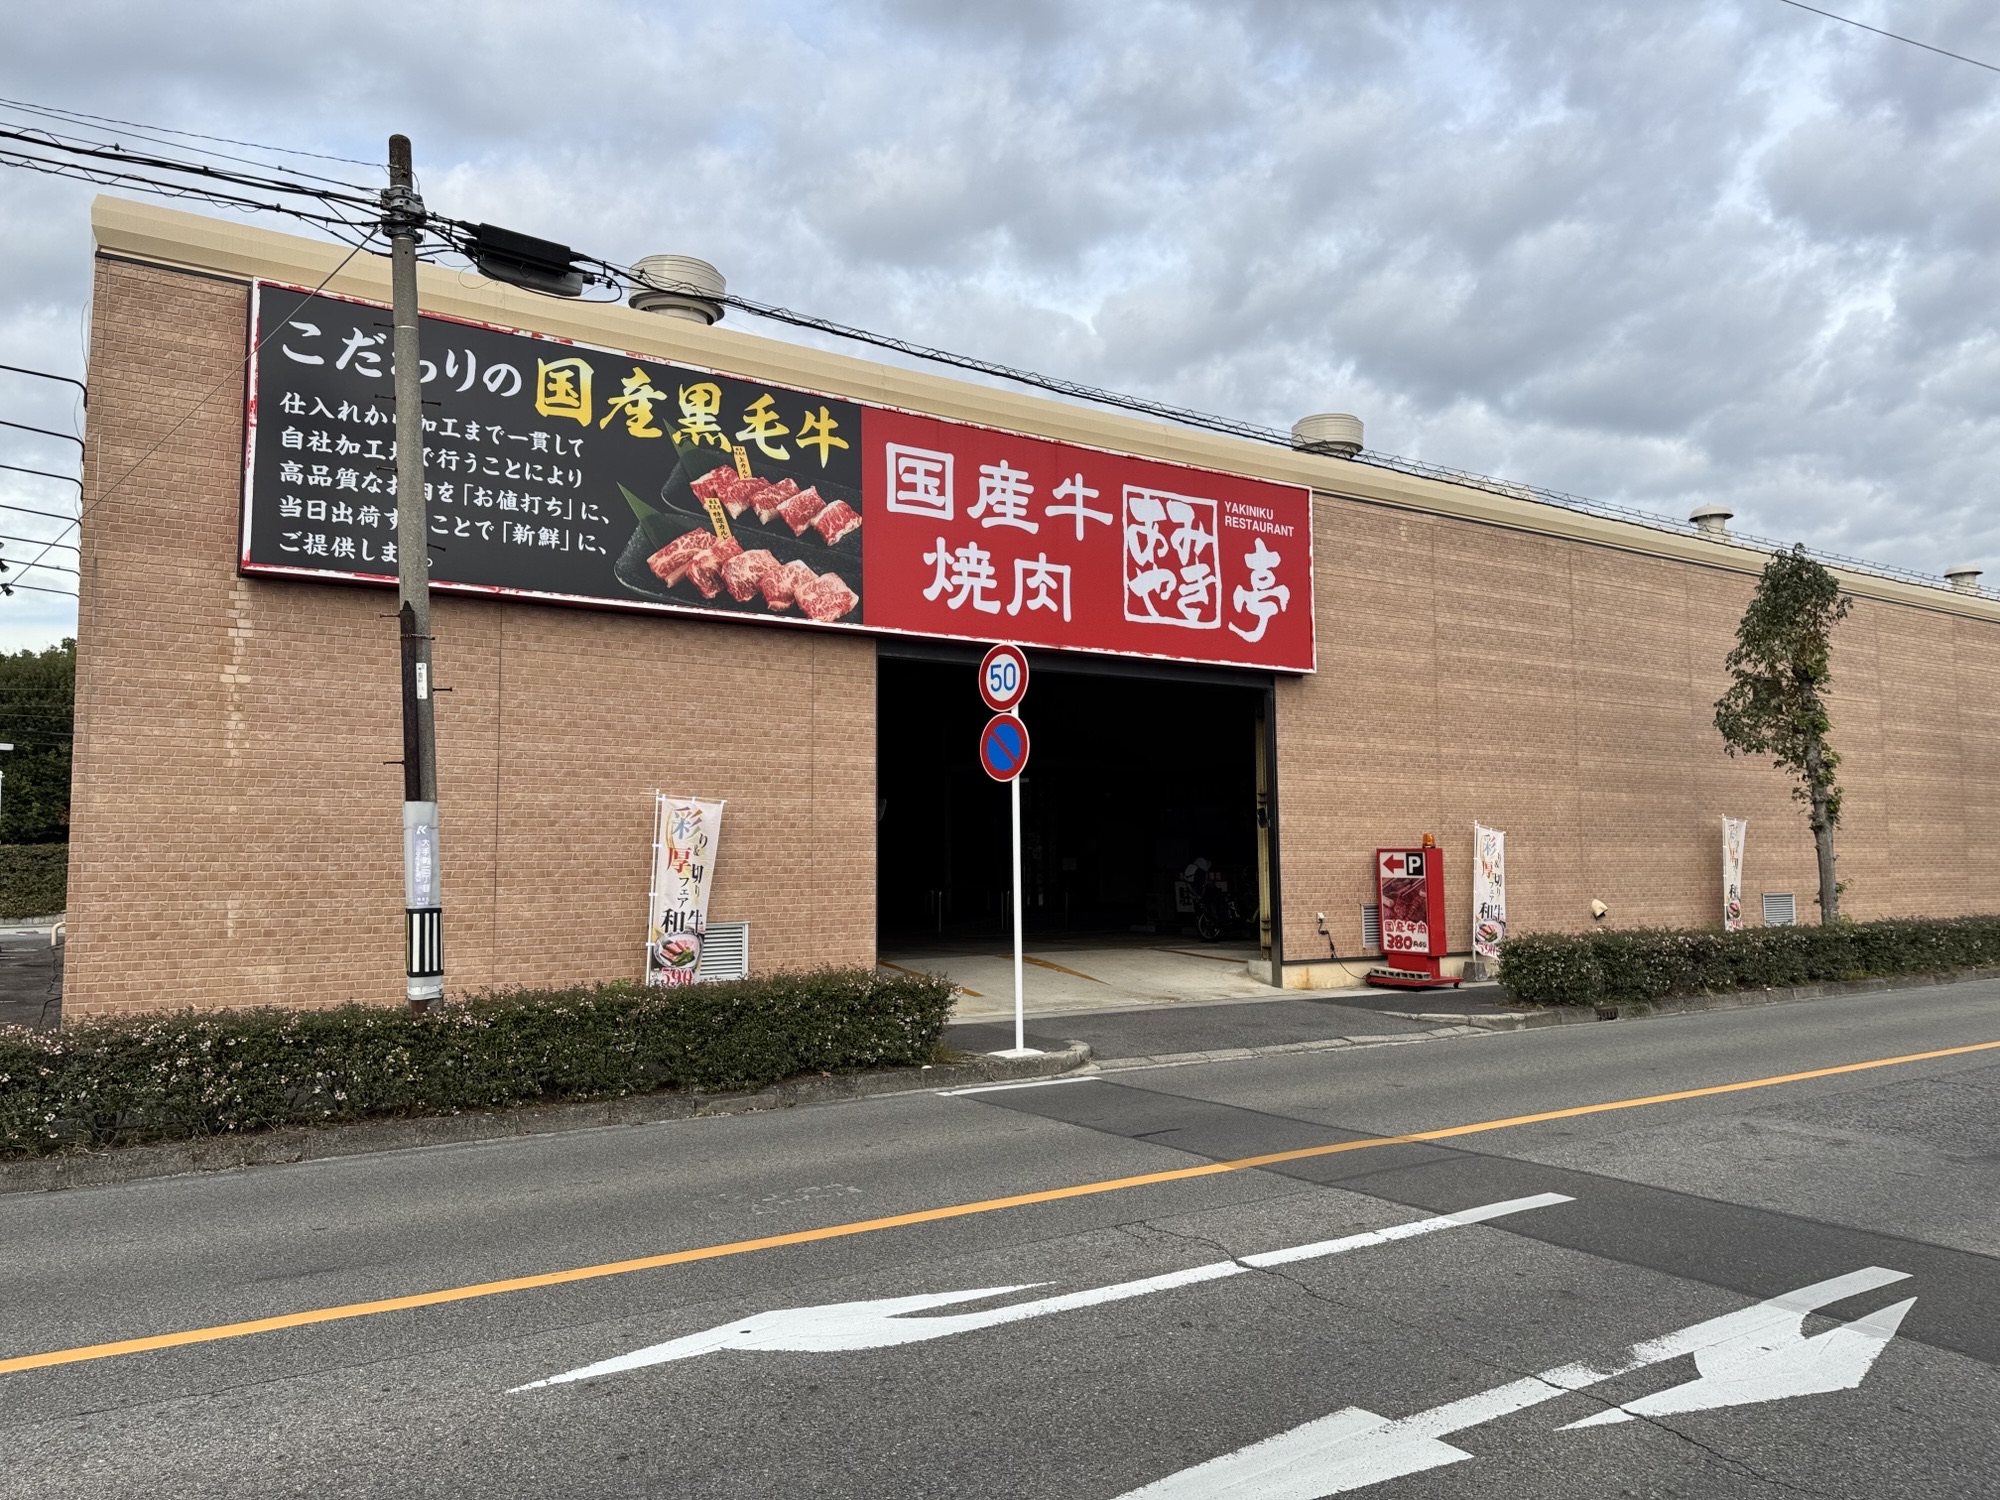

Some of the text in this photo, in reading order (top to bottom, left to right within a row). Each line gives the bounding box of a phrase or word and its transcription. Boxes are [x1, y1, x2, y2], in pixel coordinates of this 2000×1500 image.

[280, 392, 584, 457] 仕入れか加工まで一貫して
[886, 442, 1113, 541] 国産牛
[280, 496, 607, 555] 当日出荷すことで「新鮮」に、
[1224, 501, 1274, 520] YAKINIKU
[1225, 515, 1295, 537] RESTAURANT
[280, 532, 433, 567] ご提供しま。
[922, 537, 1072, 622] 焼肉
[1228, 538, 1290, 642] 亭
[990, 662, 1016, 692] 50
[1408, 856, 1421, 874] P
[660, 908, 703, 934] 和牛
